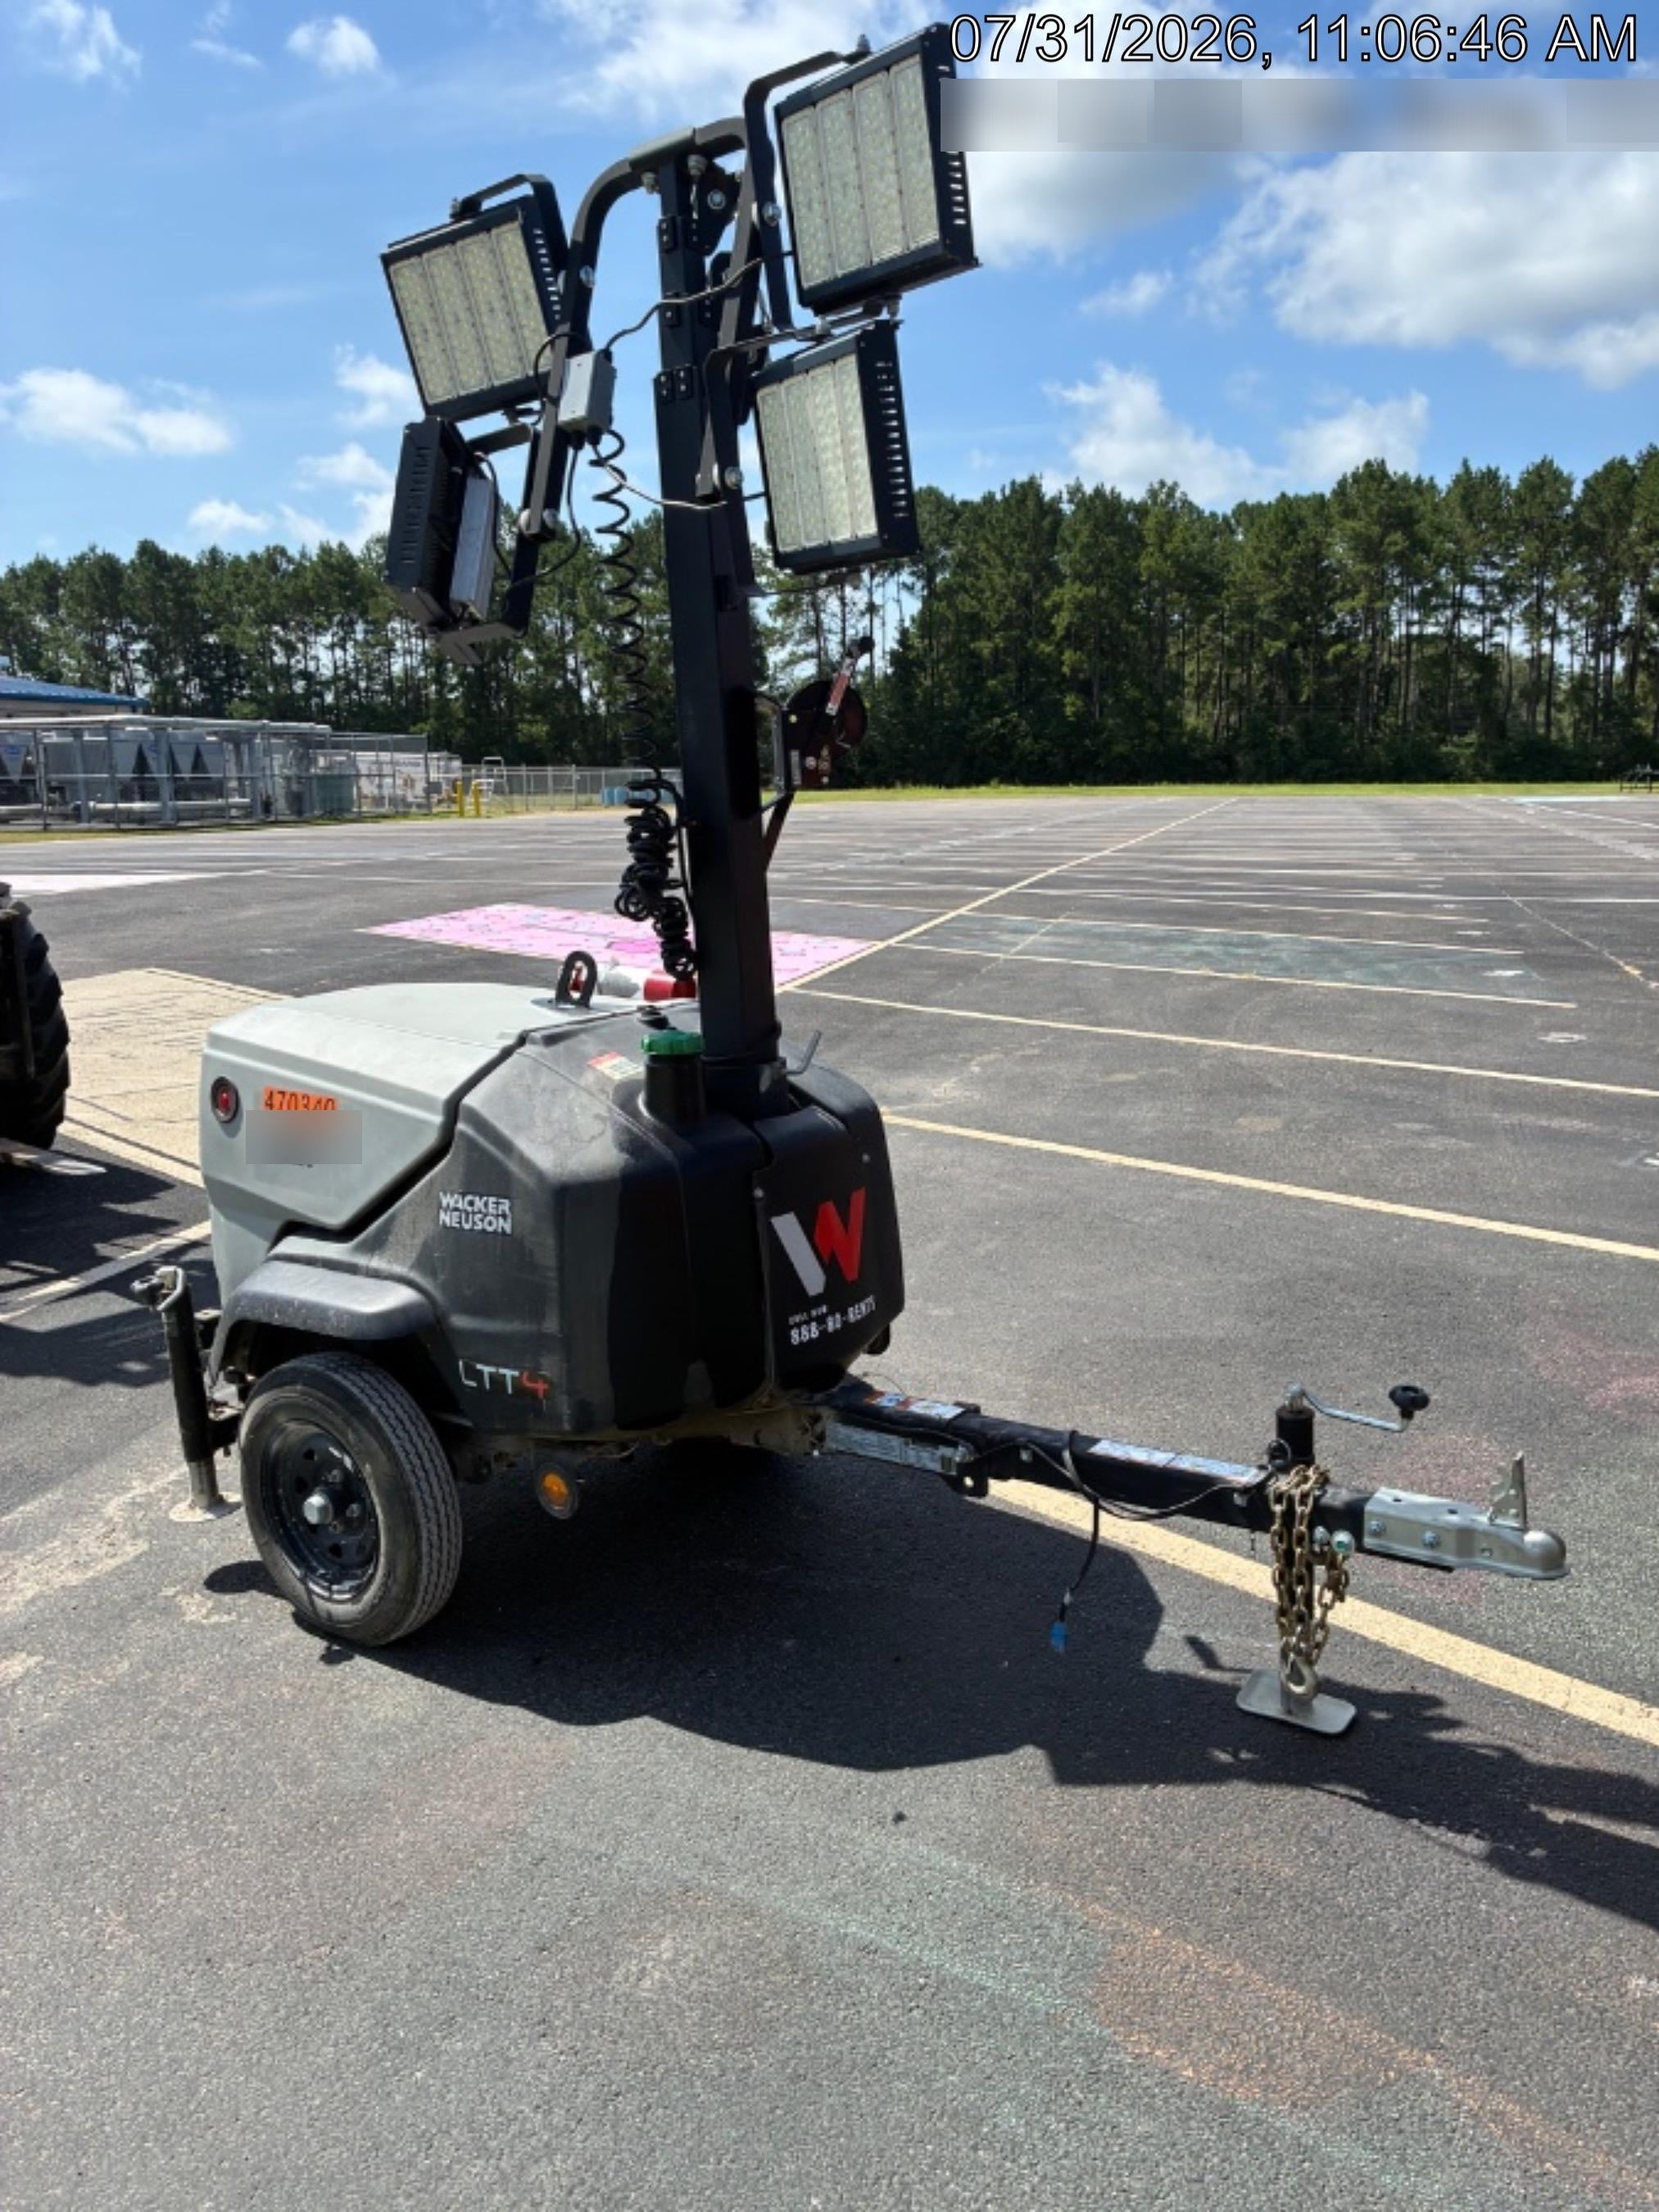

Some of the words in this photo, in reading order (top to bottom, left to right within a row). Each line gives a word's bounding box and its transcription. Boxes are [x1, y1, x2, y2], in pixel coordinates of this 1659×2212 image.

[439, 1191, 511, 1215] WACKER
[439, 1208, 512, 1235] NEUSON
[459, 1359, 549, 1399] LTT4
